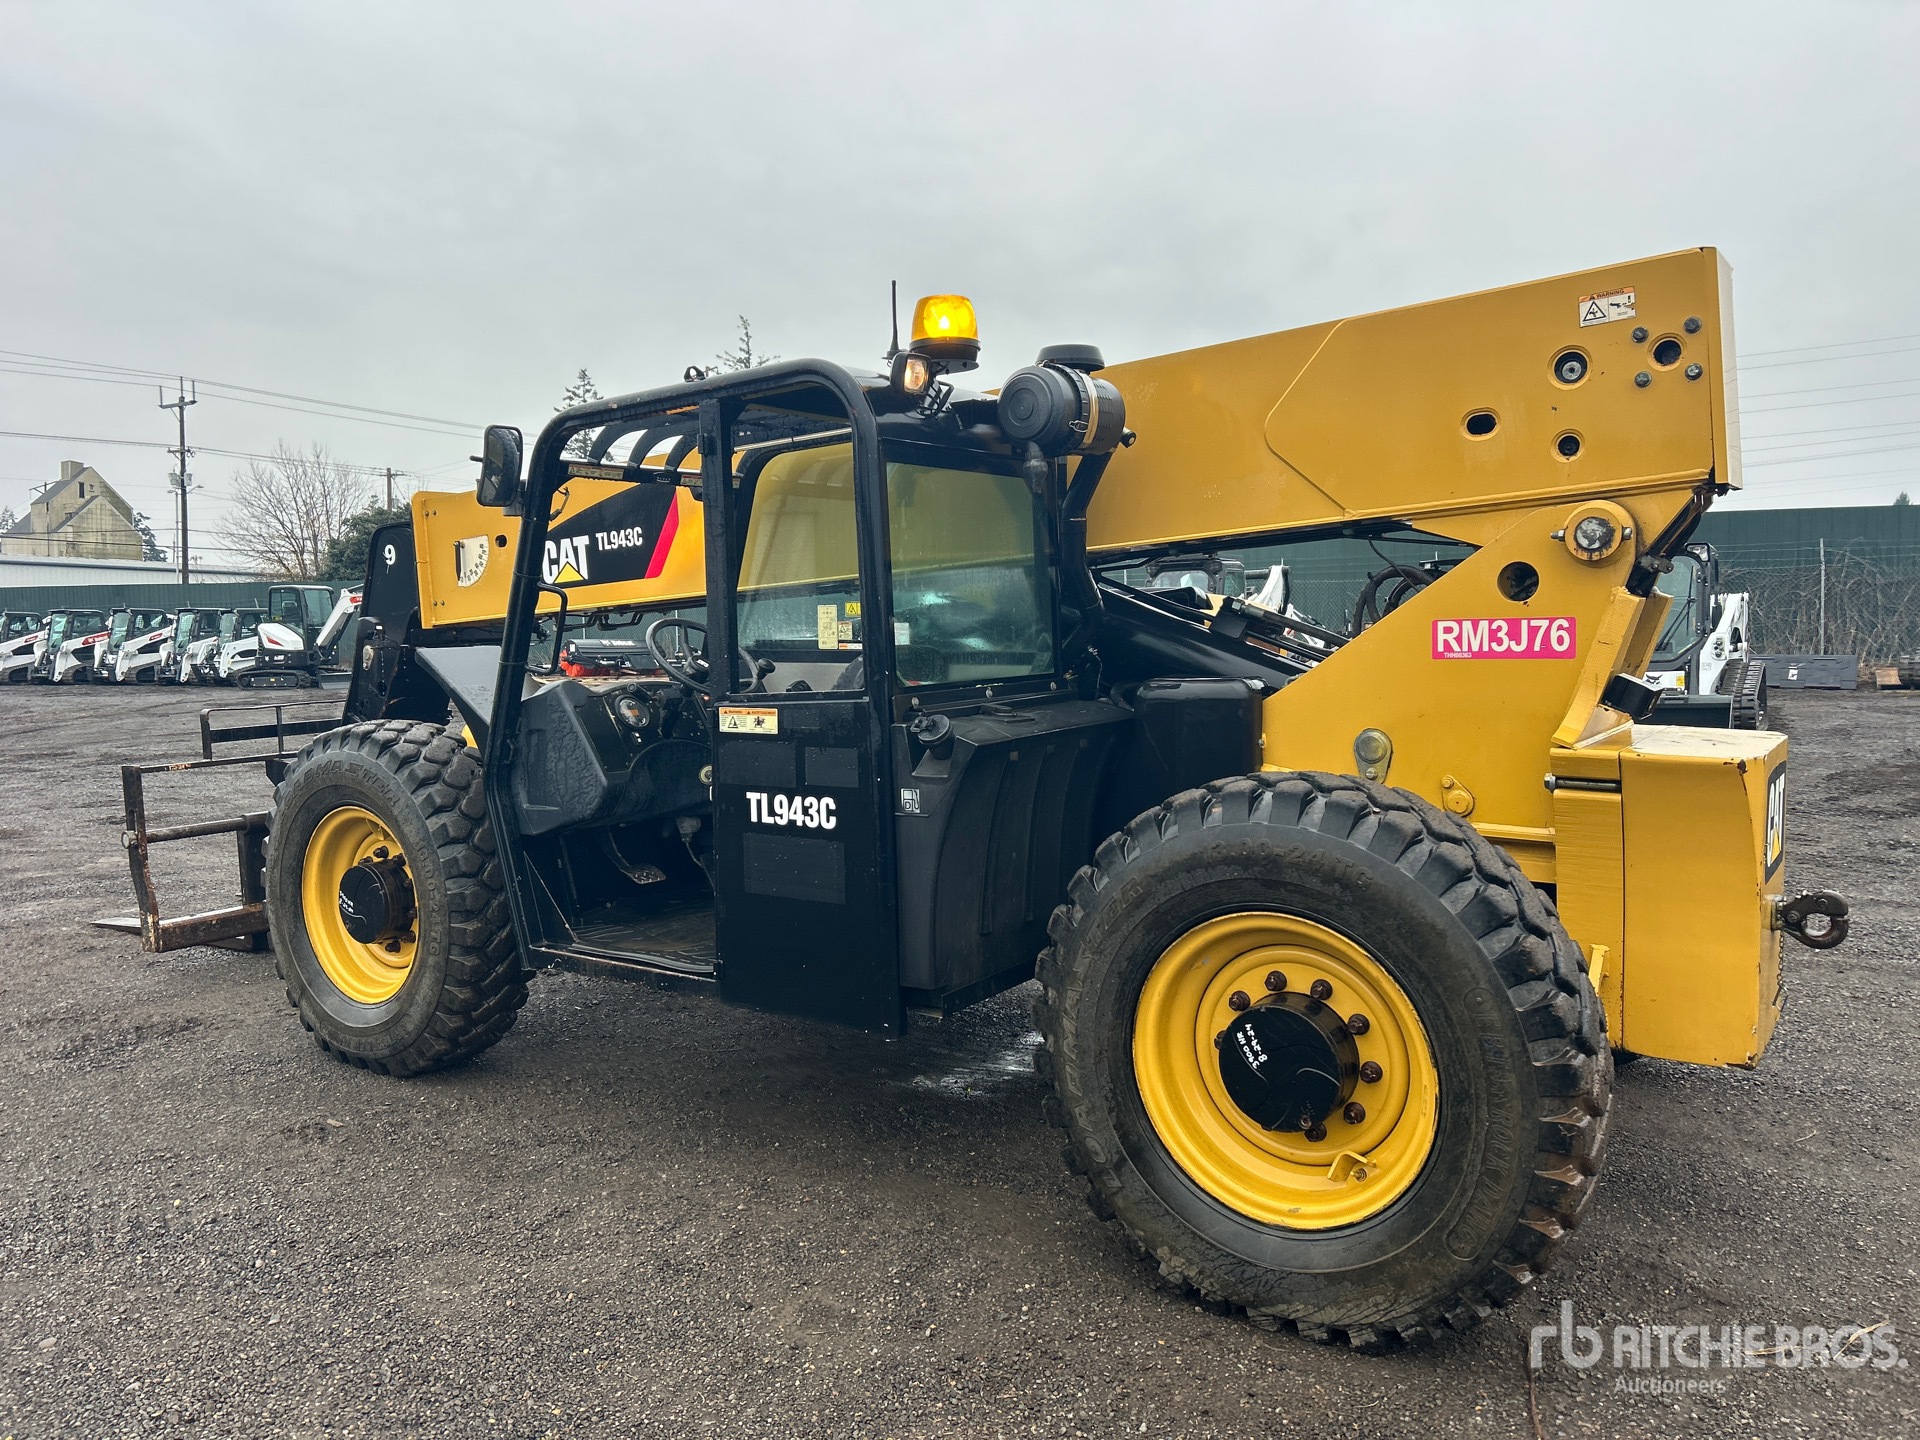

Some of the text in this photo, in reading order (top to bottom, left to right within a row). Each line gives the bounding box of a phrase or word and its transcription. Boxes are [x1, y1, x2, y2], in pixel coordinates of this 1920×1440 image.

[1597, 288, 1625, 299] WARNING
[383, 544, 396, 566] 9
[542, 526, 643, 584] CAT TL943C
[1437, 618, 1571, 652] RM3J76
[746, 791, 837, 830] TL943C
[1766, 773, 1785, 867] CAT
